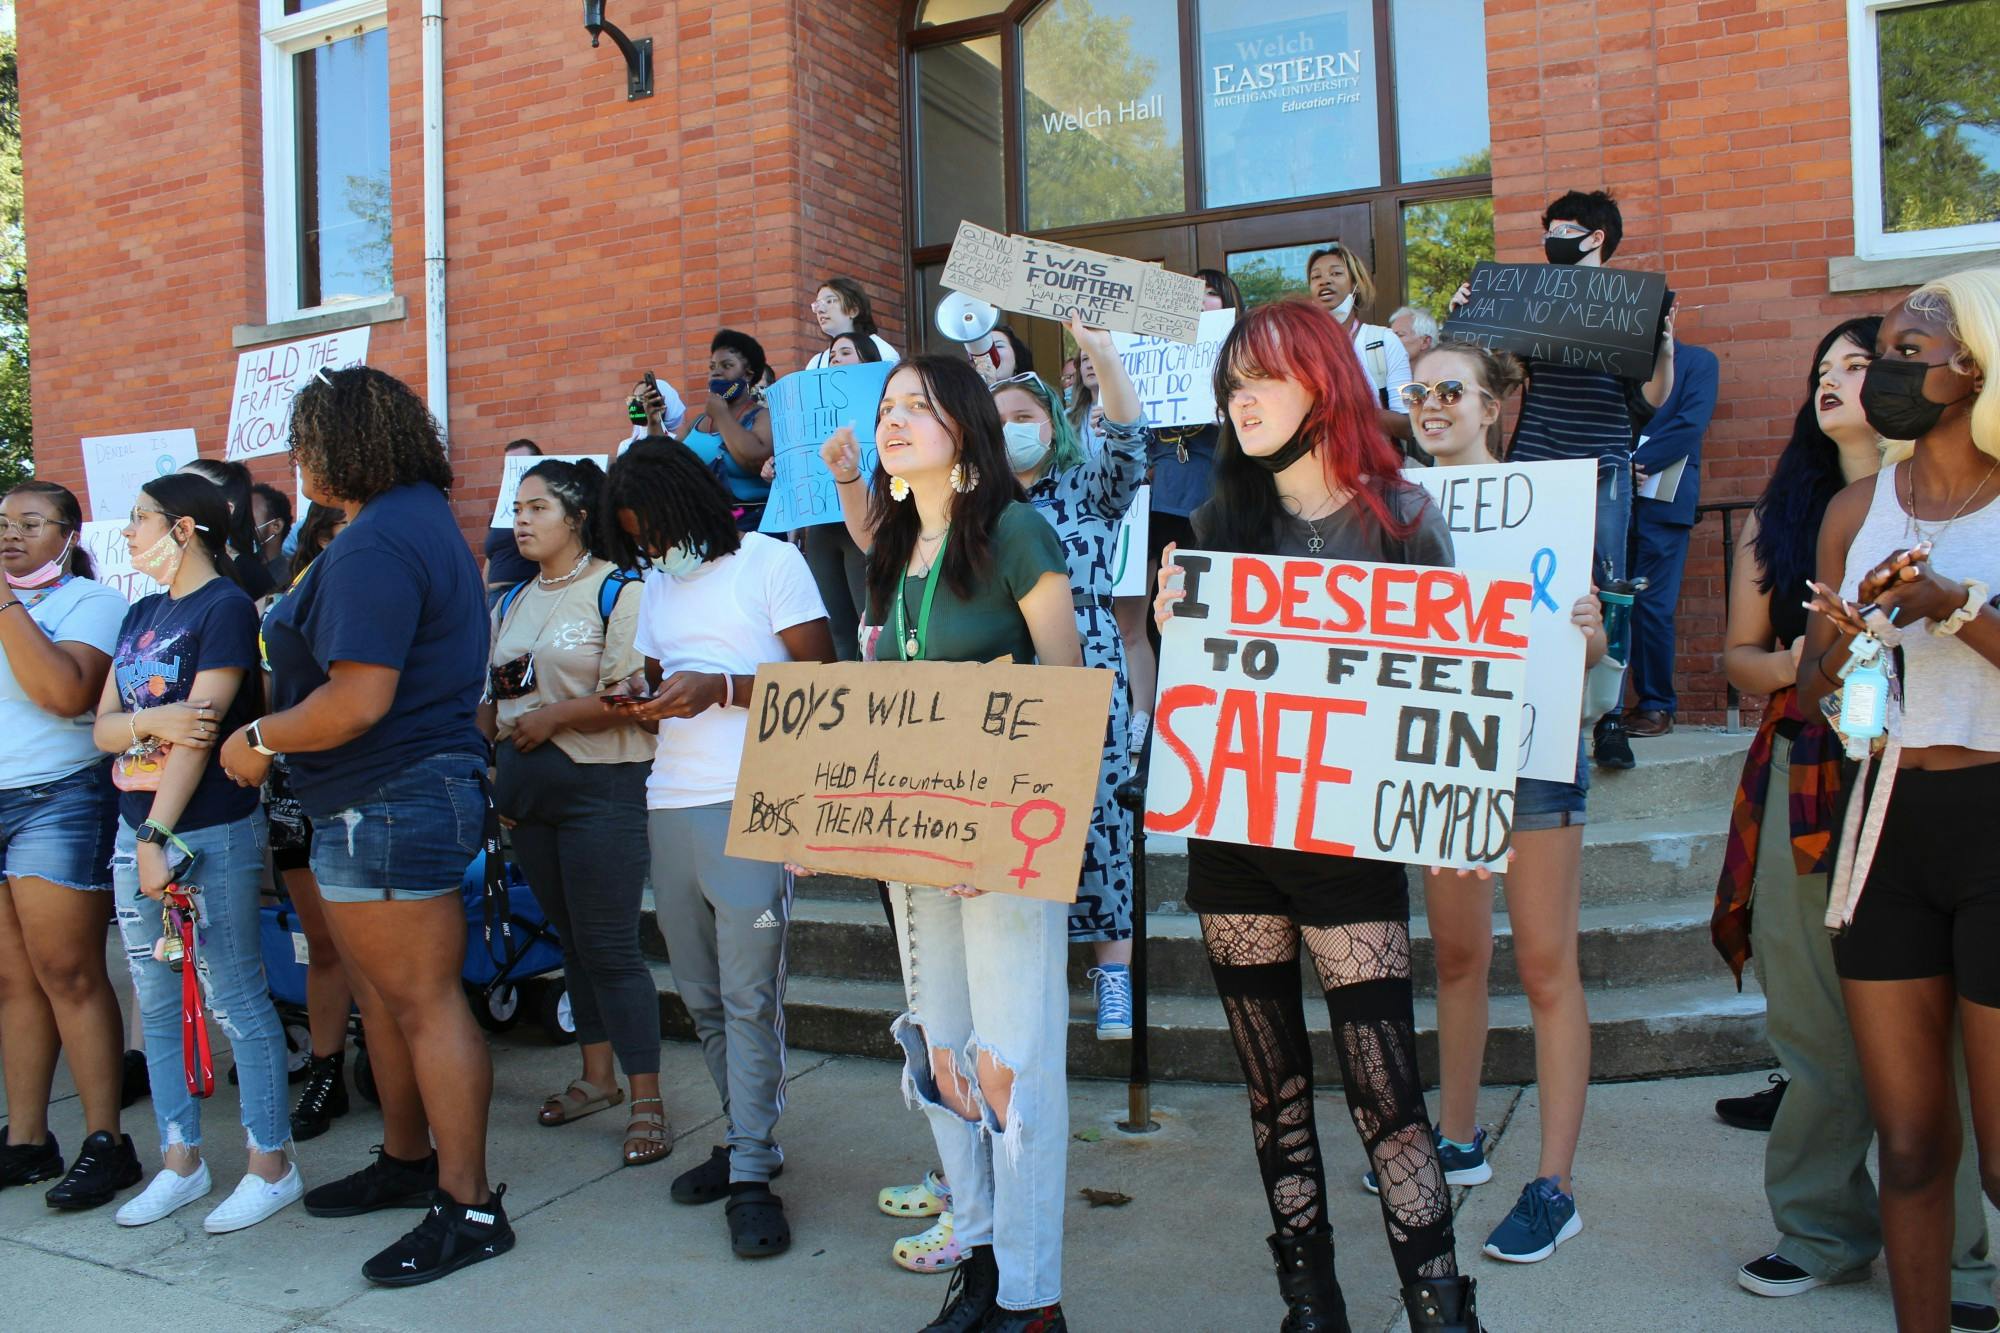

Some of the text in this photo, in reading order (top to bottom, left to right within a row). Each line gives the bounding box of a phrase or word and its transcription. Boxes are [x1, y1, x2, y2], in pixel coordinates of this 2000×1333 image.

[1236, 31, 1314, 61] Welch
[1213, 49, 1361, 96] EASTERN
[1213, 76, 1360, 108] MICHIGAN UNIVERSITY
[1281, 91, 1360, 113] Education First
[1042, 94, 1162, 134] Welch Hall
[1022, 250, 1108, 277] I WAS
[1026, 266, 1134, 302] FOURTEEN.
[1032, 289, 1073, 304] WALKS
[1471, 268, 1646, 305] EVEN DOGS KNOW
[1022, 297, 1042, 312] I
[1458, 298, 1514, 321] WHAT
[1559, 303, 1649, 336] MEANS
[308, 338, 338, 369] THE
[237, 379, 296, 420] FRATS
[813, 370, 849, 411] IS
[1166, 373, 1192, 395] DO
[150, 438, 168, 451] IS
[1171, 555, 1211, 620] I
[1231, 557, 1533, 648] DESERVE
[1204, 638, 1514, 700] TO FEEL
[757, 681, 1044, 743] BOYS WILL BE
[862, 750, 989, 792] Accountable
[1010, 773, 1055, 795] For
[1143, 684, 1368, 858] SAFE
[1395, 705, 1501, 772] ON
[1373, 779, 1515, 864] CAMPUS
[502, 922, 510, 937] NIKE
[465, 1209, 495, 1225] PUMA
